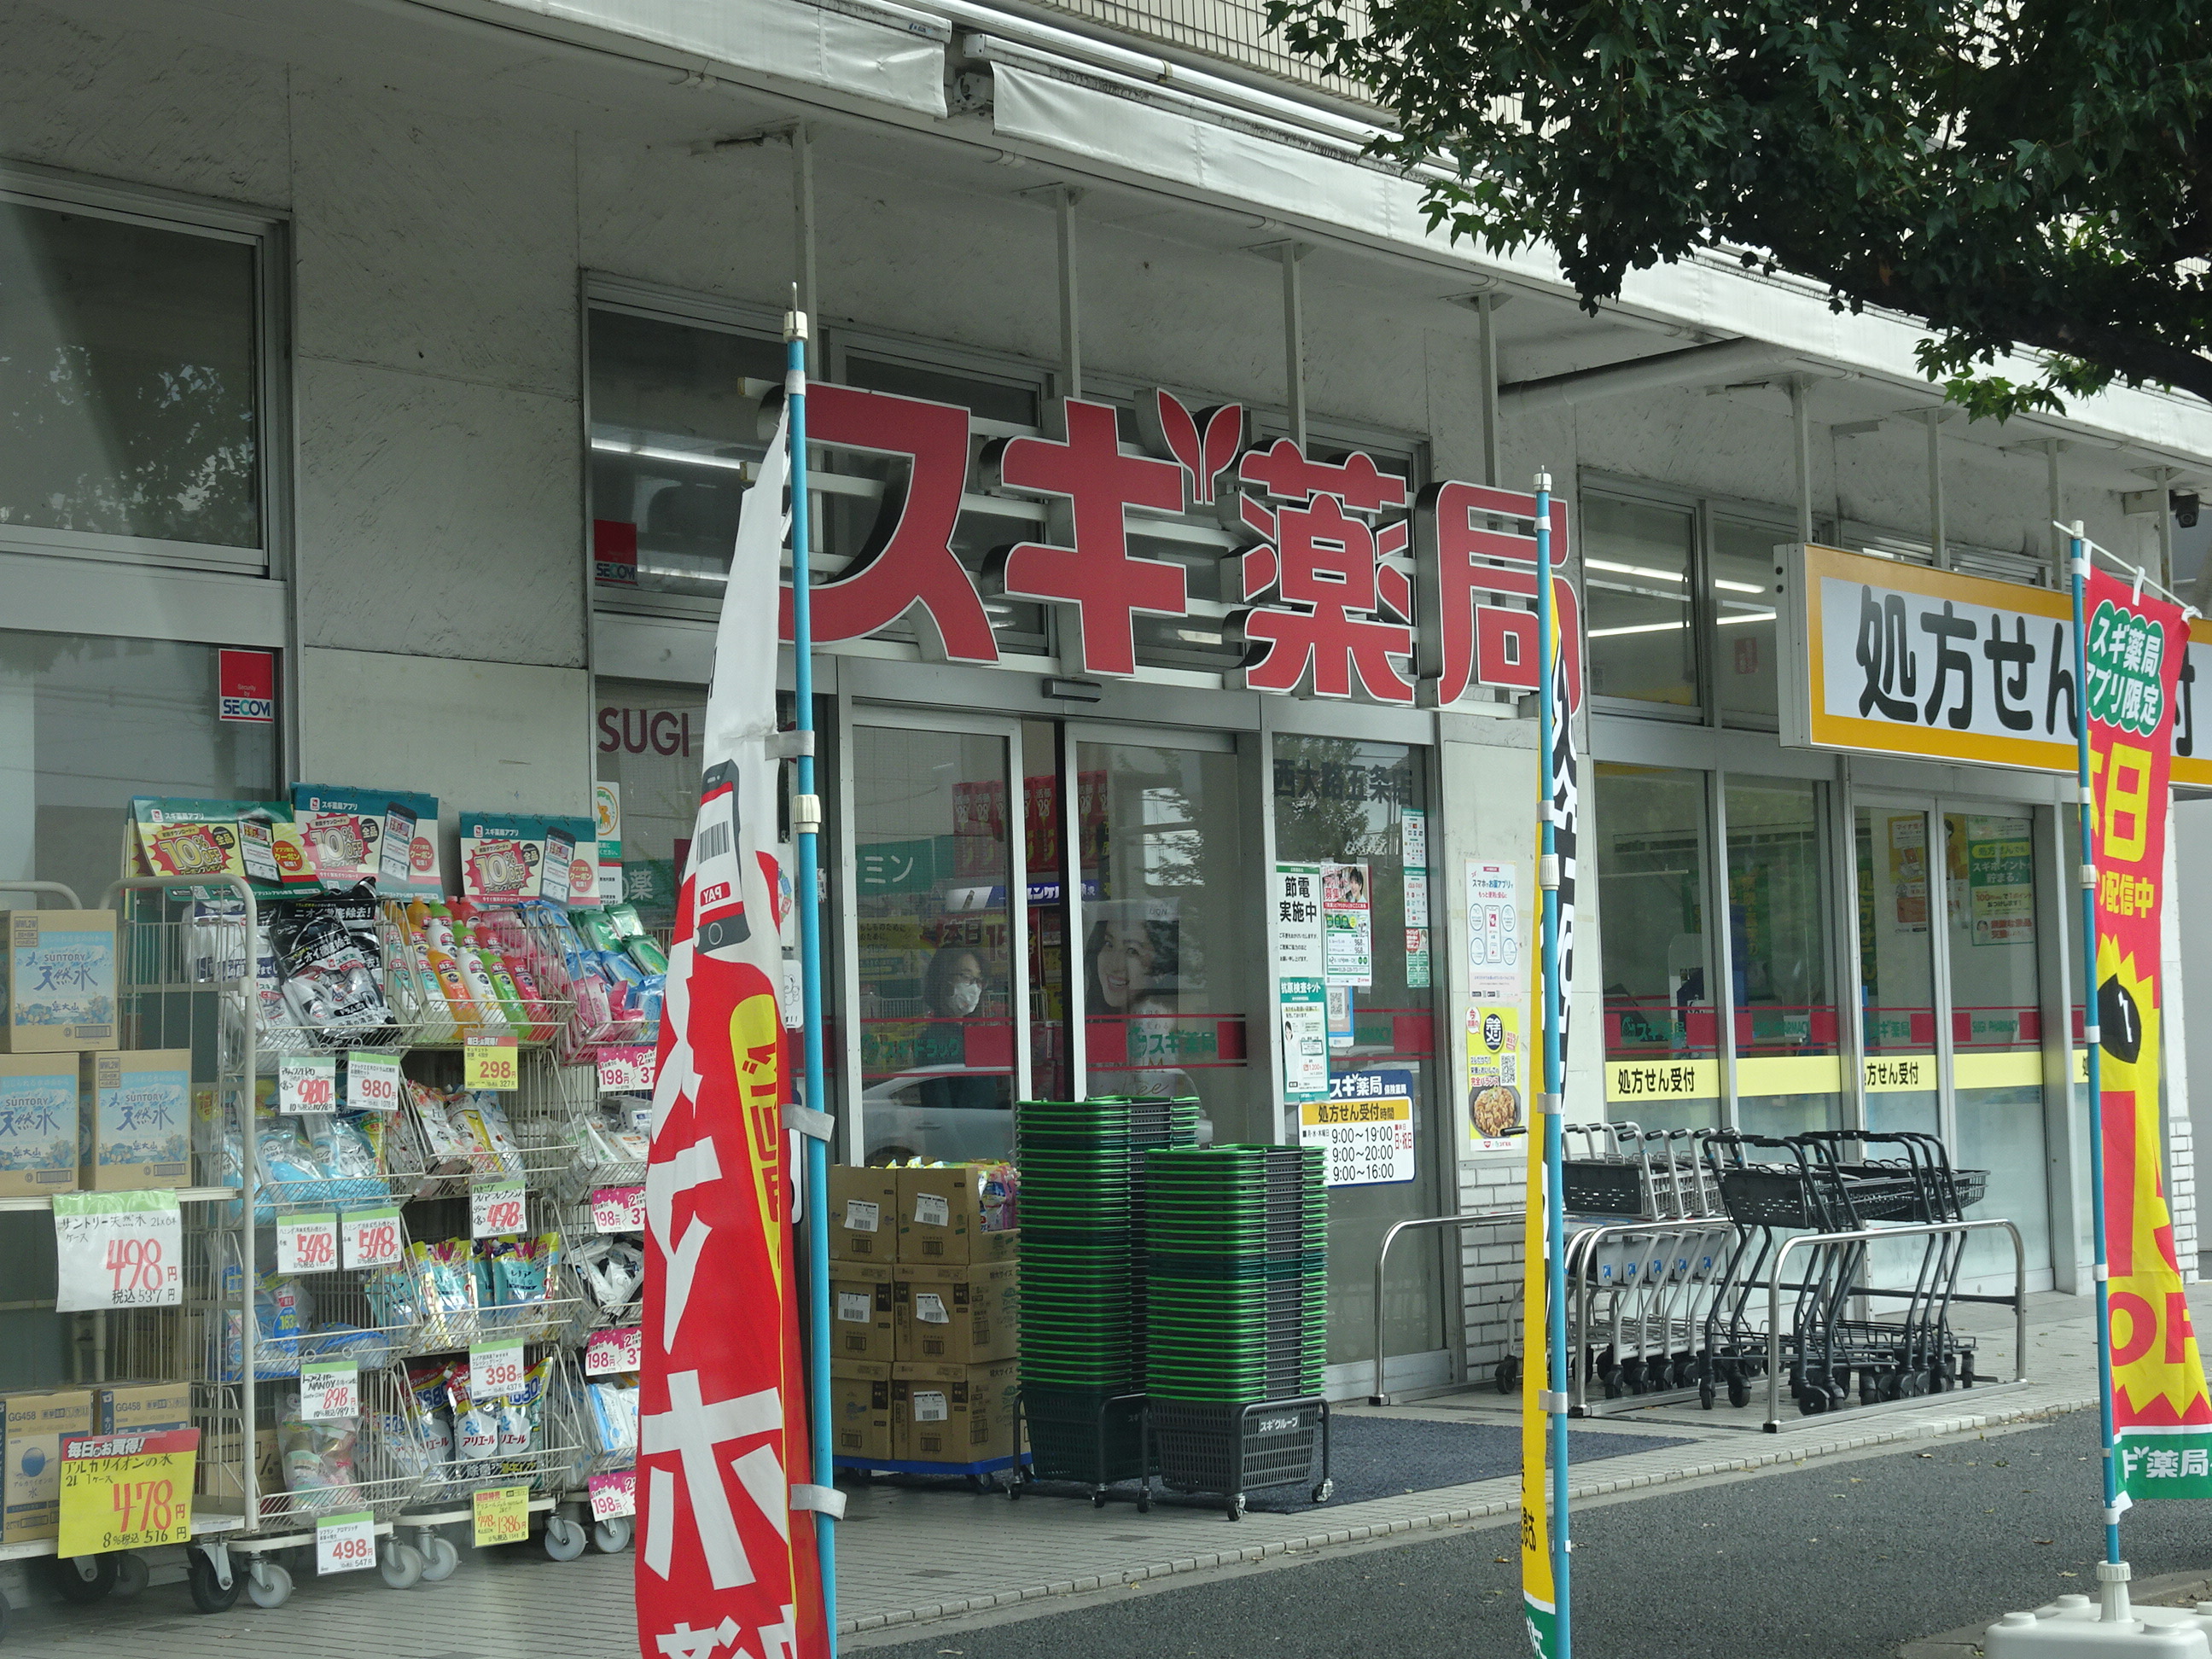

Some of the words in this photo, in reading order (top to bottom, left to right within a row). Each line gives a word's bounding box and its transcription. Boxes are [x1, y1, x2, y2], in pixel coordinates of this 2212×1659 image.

[778, 381, 1580, 718] スギ薬局
[597, 562, 636, 579] SECOM
[2093, 614, 2161, 680] スギ薬局
[237, 684, 256, 692] Security
[224, 699, 271, 716] SECOM
[598, 707, 690, 757] SUGI
[214, 834, 233, 847] 全品
[361, 827, 377, 838] 全品
[201, 847, 222, 864] OFF
[274, 852, 300, 861] クーポン
[346, 841, 363, 856] OFF
[410, 849, 433, 859] クーポン
[523, 852, 538, 861] 全品
[509, 864, 525, 881] OFF
[570, 872, 592, 882] クーポン
[1284, 876, 1310, 898] 節電
[1280, 901, 1317, 923] 実施中
[44, 953, 85, 963] SUNTORY
[33, 964, 98, 991] 天然水
[1281, 982, 1321, 994] 抗原検査キット
[1618, 1066, 1695, 1095] 処方せん受付
[1864, 1062, 1918, 1086] 方せん受付
[1330, 1073, 1382, 1098] スギ薬局
[5, 1097, 49, 1107] SUNTORY
[125, 1092, 164, 1103] SUNTORY
[116, 1106, 175, 1131] 天然水
[1318, 1102, 1394, 1123] 処方せん受付時間
[0, 1109, 61, 1137] 天然水
[61, 1214, 147, 1230] サントリー天然水
[486, 1365, 522, 1386] 398円
[115, 1402, 141, 1412] GG458
[9, 1412, 36, 1422] GG458
[1260, 1416, 1298, 1432] スギグループ
[463, 1434, 496, 1447] アリエール
[65, 1453, 173, 1475] アルカリイオンの水
[28, 1487, 38, 1499] 水
[332, 1539, 373, 1560] 498円
